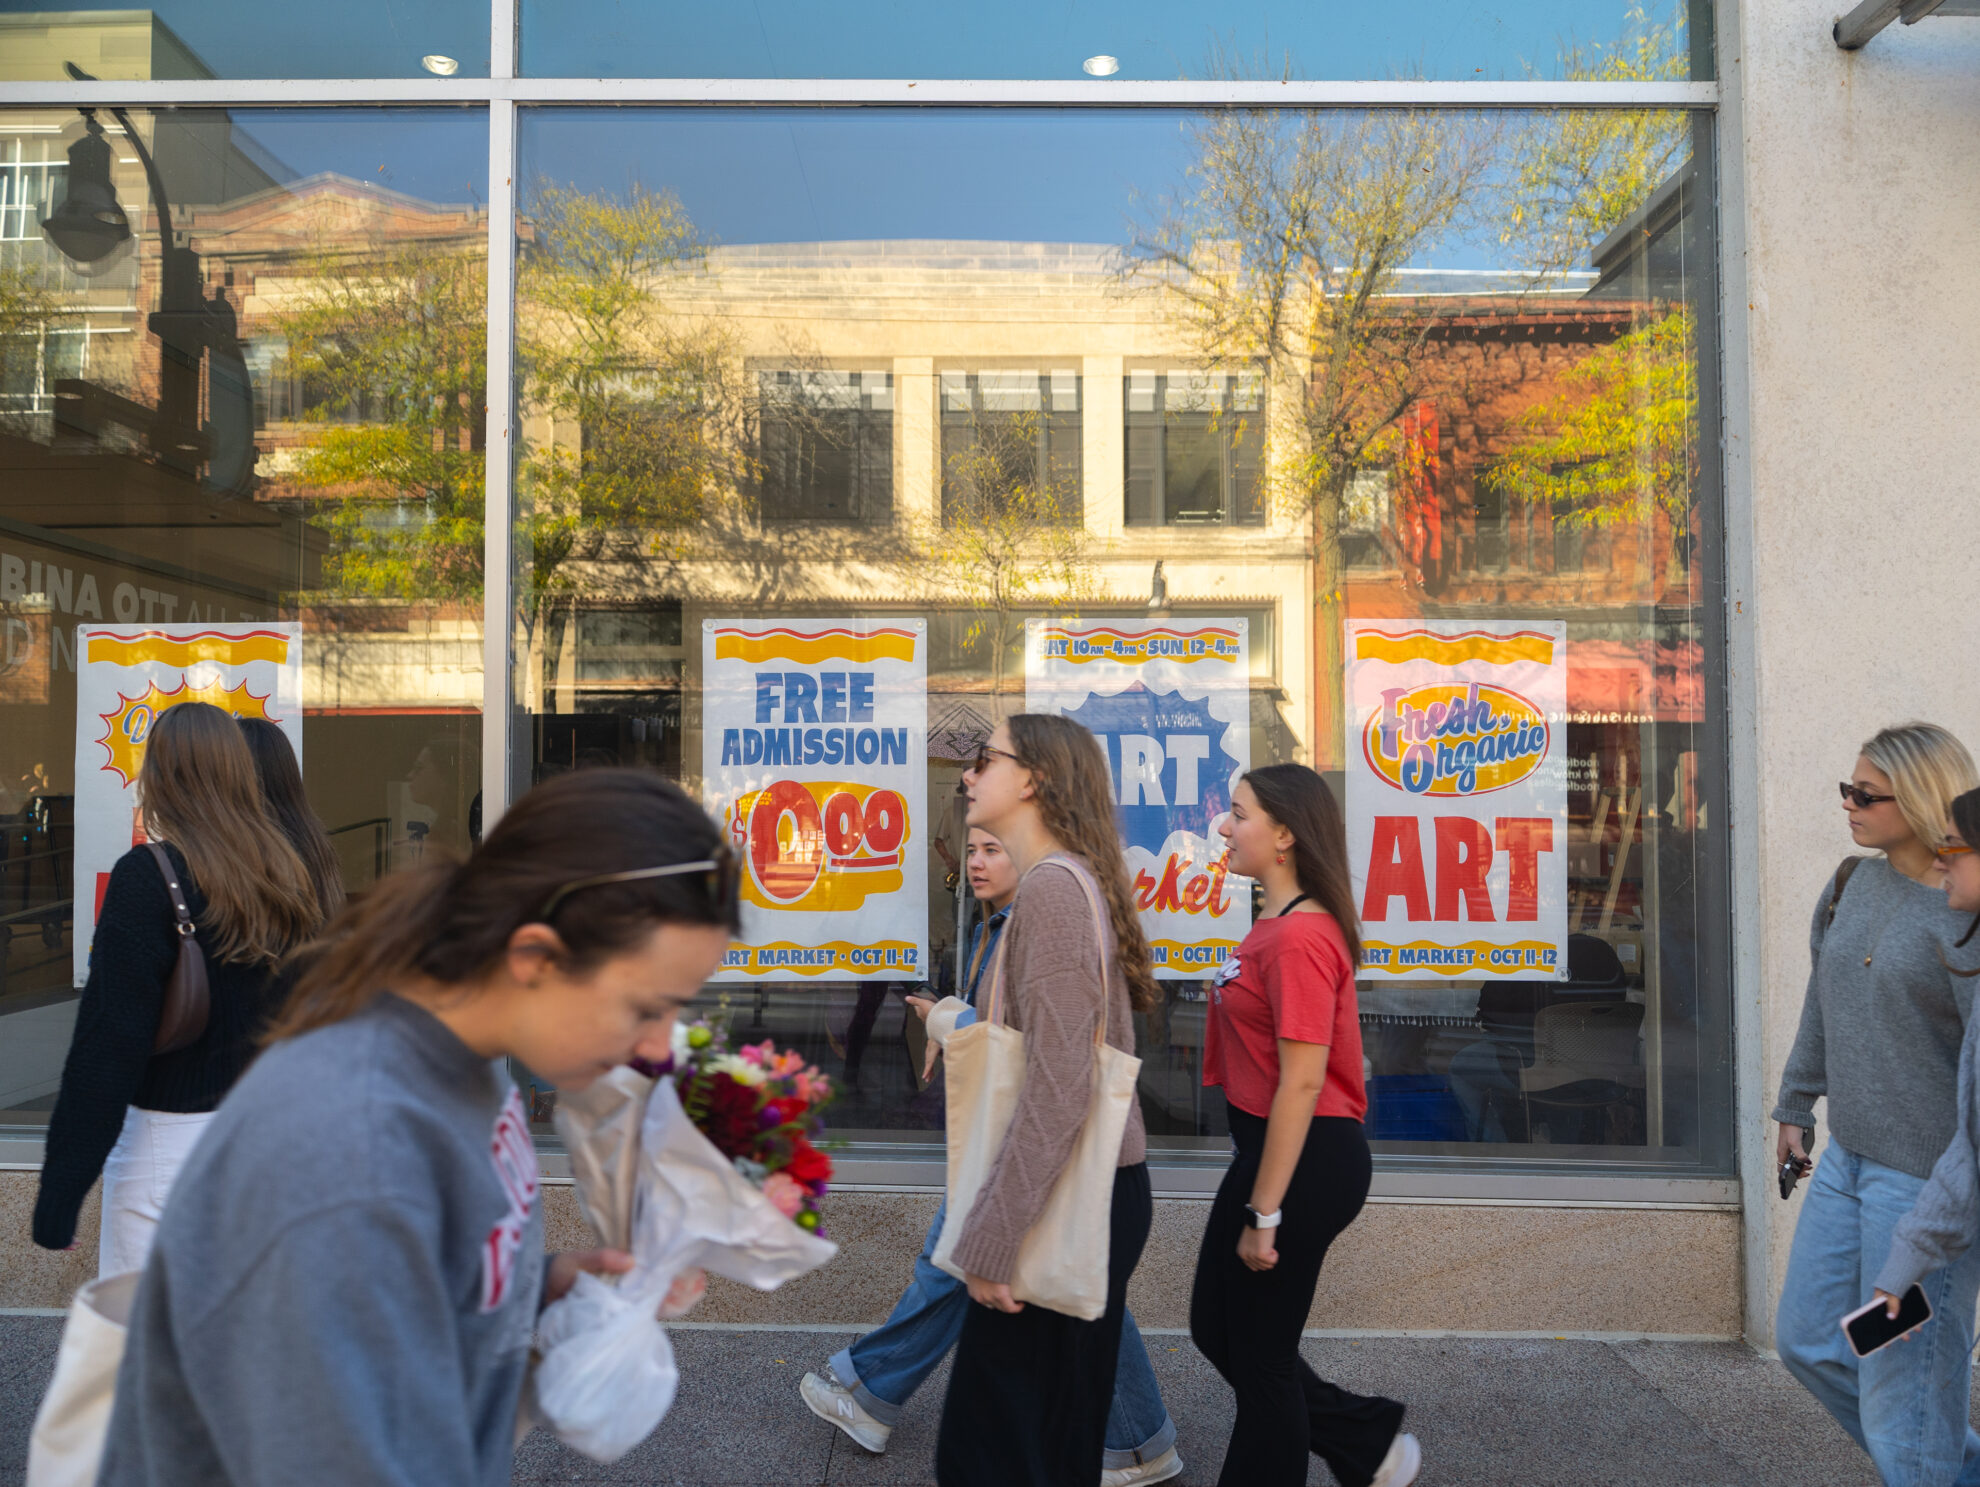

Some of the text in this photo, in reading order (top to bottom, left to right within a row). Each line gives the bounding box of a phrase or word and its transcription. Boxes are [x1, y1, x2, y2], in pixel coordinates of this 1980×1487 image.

[113, 582, 178, 624] OTT
[1037, 640, 1069, 655] AT
[755, 672, 874, 723] FREE
[721, 728, 907, 765] ADMISSION
[1402, 720, 1545, 793] Organic
[1132, 850, 1231, 918] rket
[1361, 816, 1553, 922] ART
[758, 949, 836, 965] MARKET
[851, 949, 882, 965] OCT
[885, 949, 919, 965] 11-12
[1183, 947, 1213, 963] OCT
[1400, 949, 1476, 964] MARKET
[1490, 949, 1521, 964] OCT
[1525, 949, 1558, 965] 11-12
